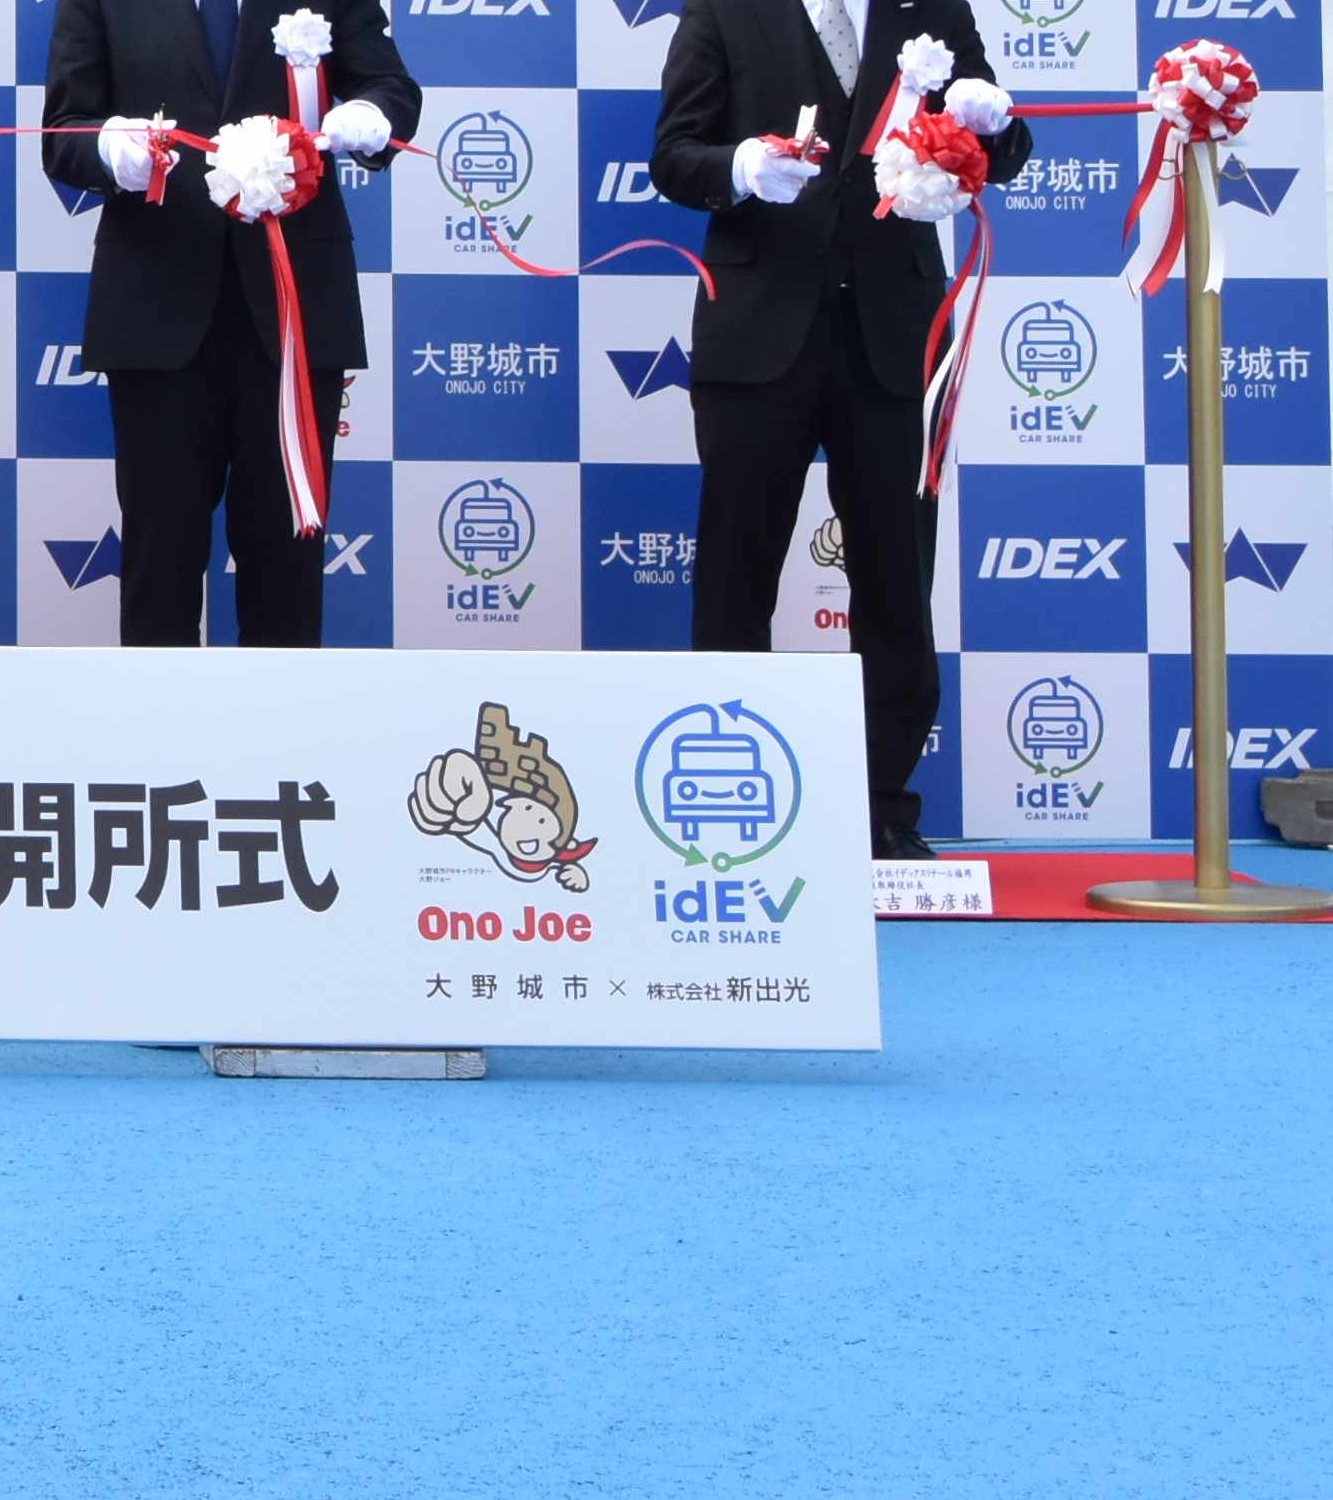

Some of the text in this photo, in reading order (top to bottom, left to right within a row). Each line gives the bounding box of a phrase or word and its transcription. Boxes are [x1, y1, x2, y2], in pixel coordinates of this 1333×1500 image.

[1013, 61, 1075, 69] CAR SHARE
[413, 342, 559, 377] 大野城市
[446, 380, 525, 394] ONOJO CITY
[979, 538, 1126, 578] IDEX
[484, 614, 519, 622] SHARE
[1025, 812, 1088, 820] CAR SHARE
[654, 875, 806, 924] idEV
[417, 906, 592, 941] Ono Joe
[671, 930, 782, 944] CAR SHARE
